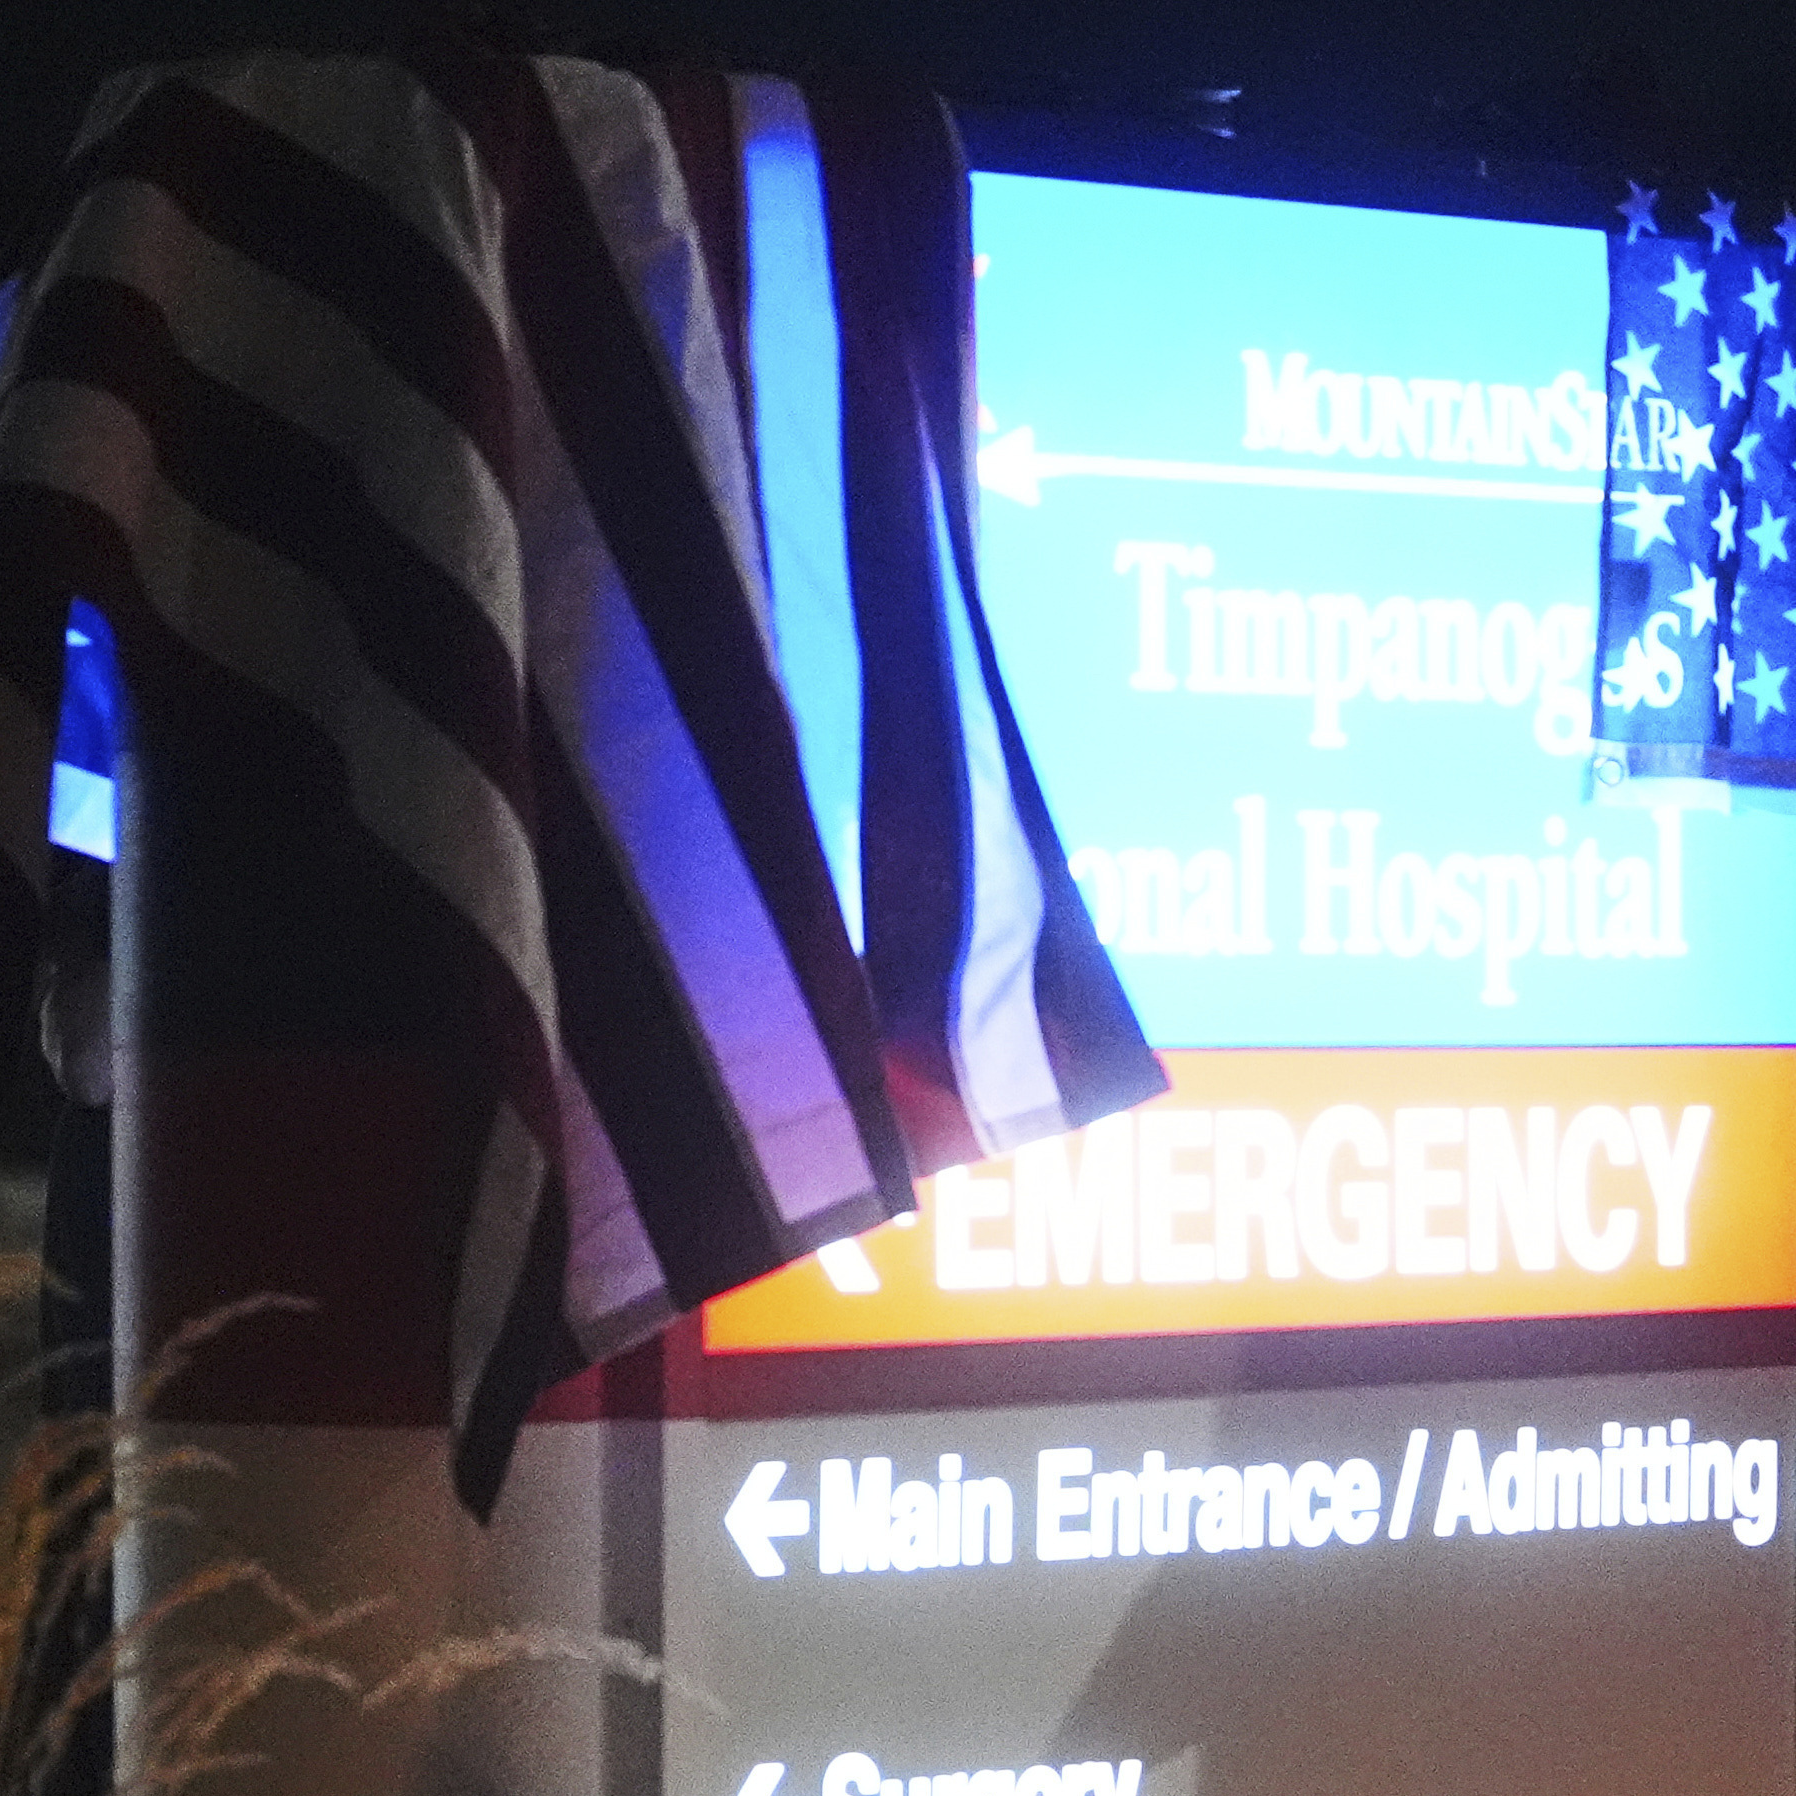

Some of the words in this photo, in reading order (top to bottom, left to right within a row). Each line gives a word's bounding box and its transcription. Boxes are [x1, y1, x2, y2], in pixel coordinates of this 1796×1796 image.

[1068, 794, 1275, 959] onal
[1295, 804, 1689, 1006] Hospital
[935, 1105, 1712, 1291] EMERGENCY
[820, 1454, 1012, 1574] Main
